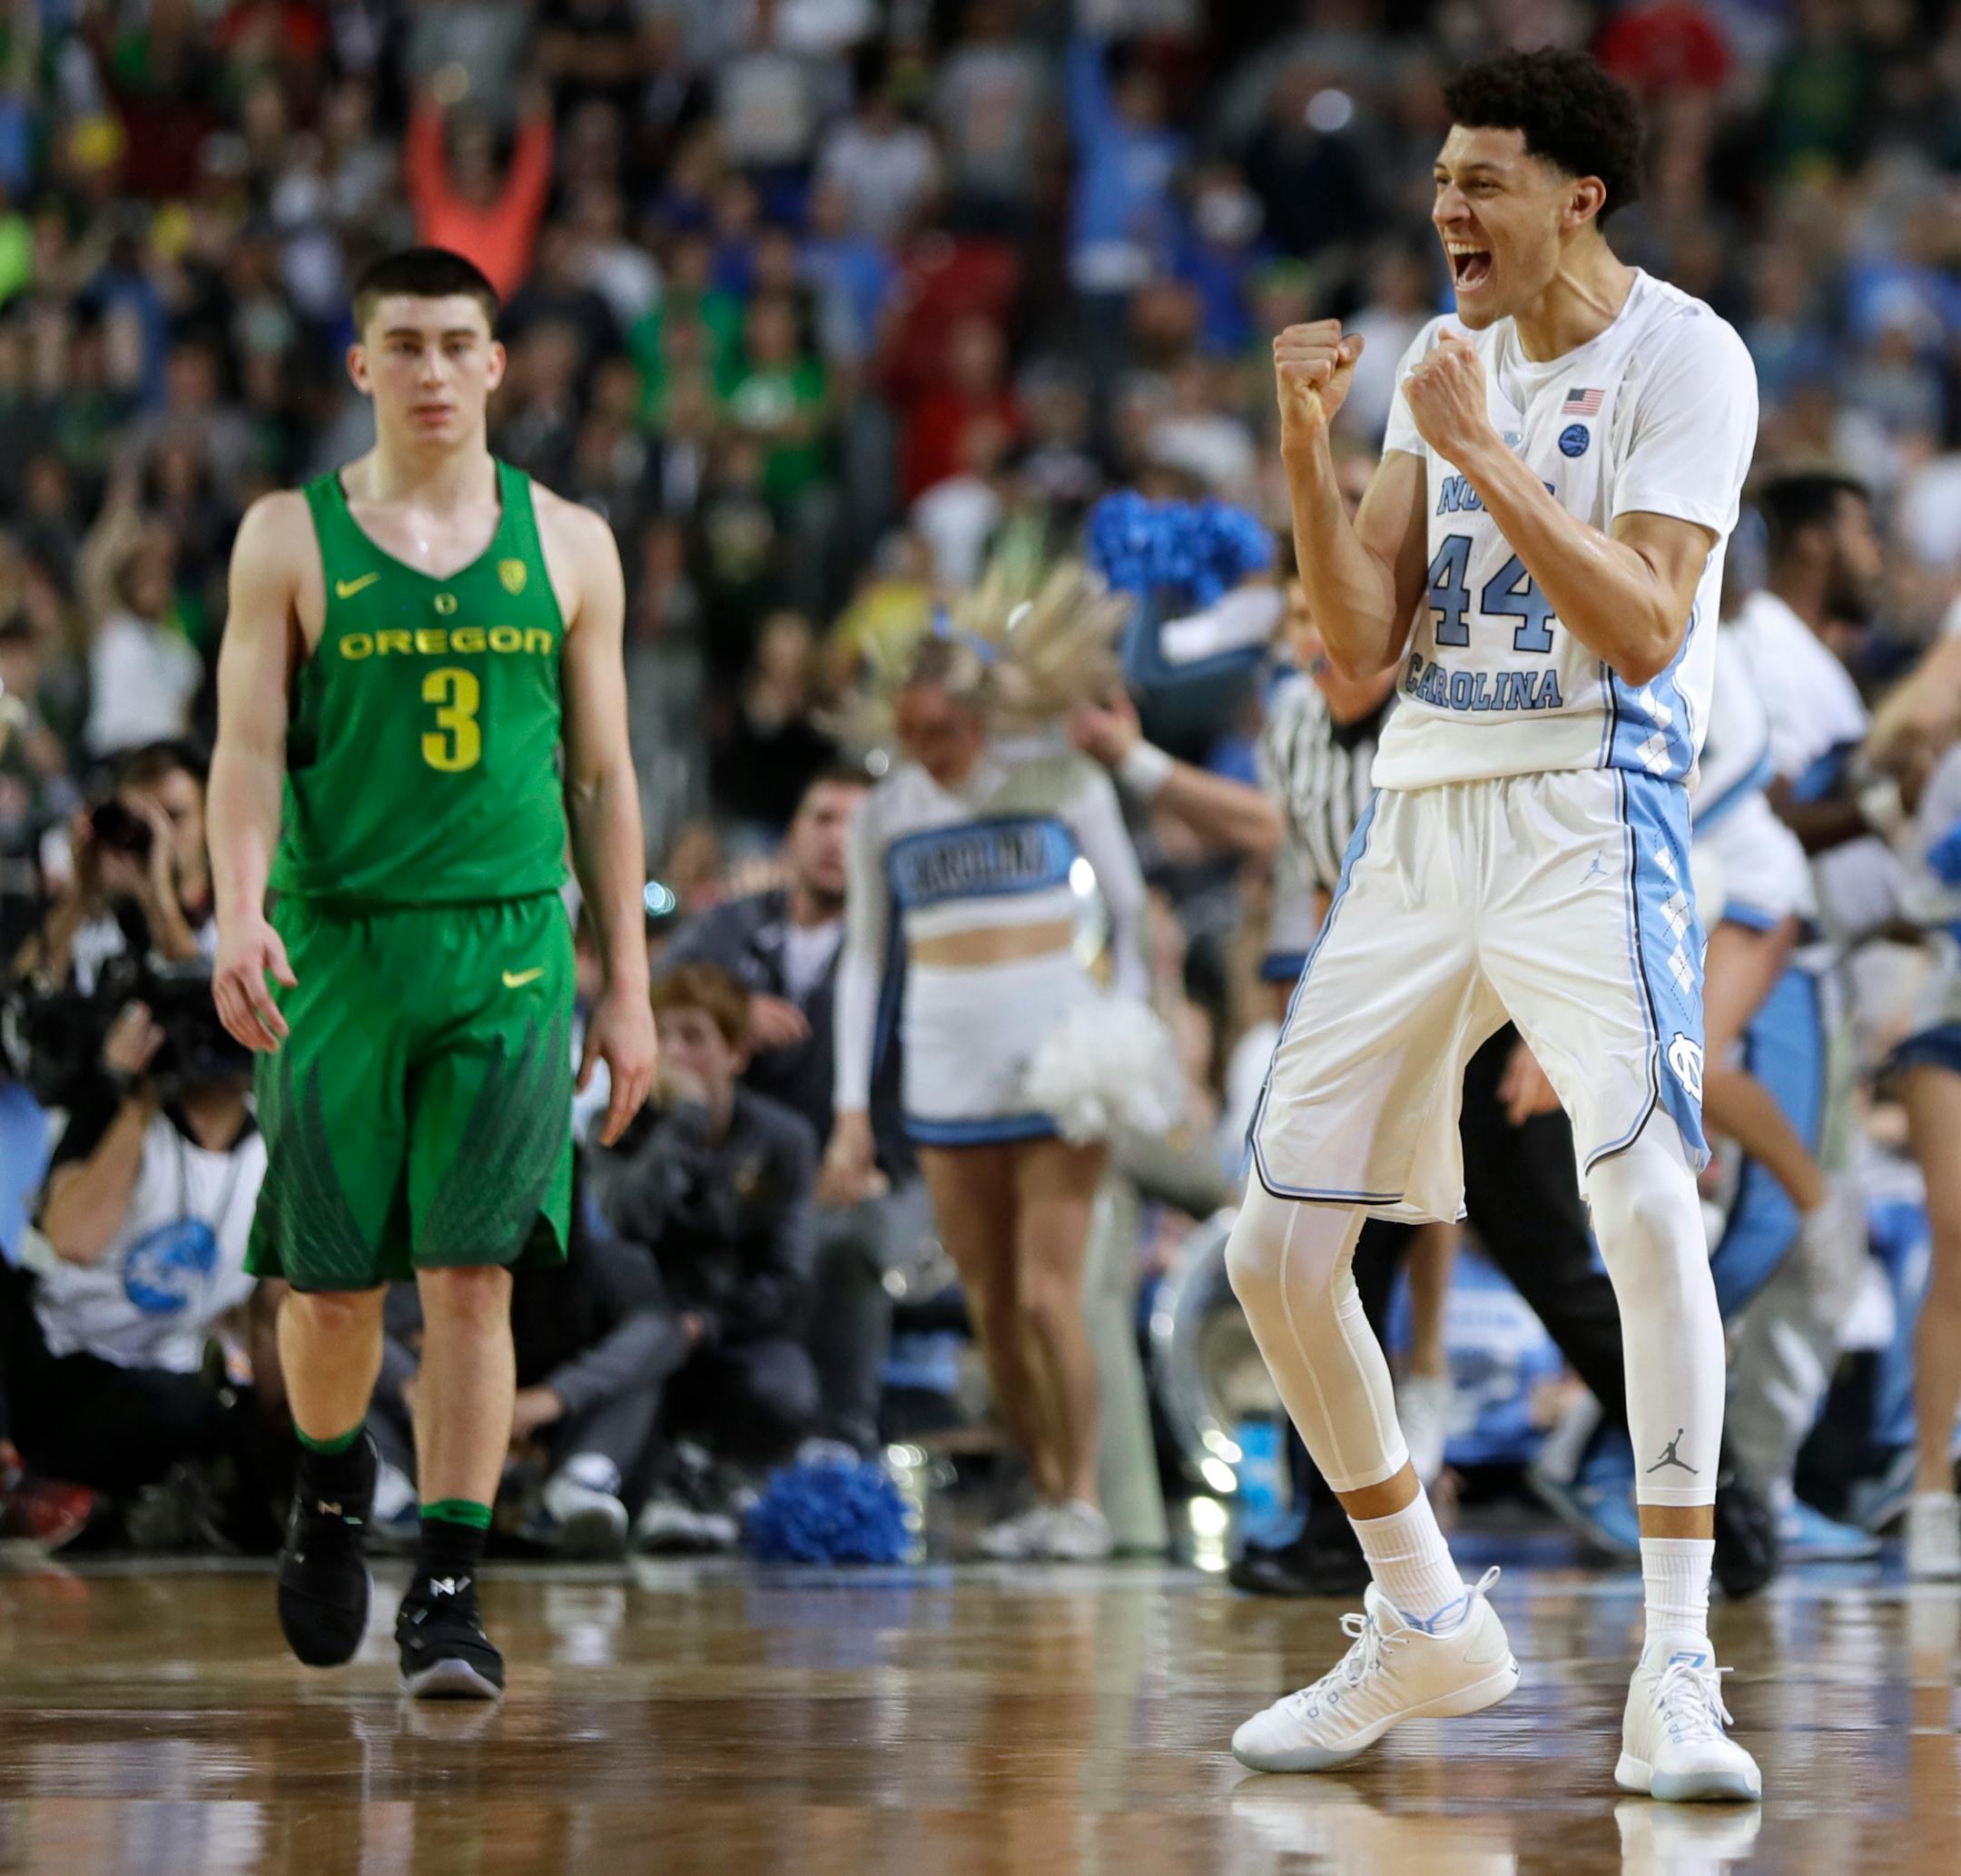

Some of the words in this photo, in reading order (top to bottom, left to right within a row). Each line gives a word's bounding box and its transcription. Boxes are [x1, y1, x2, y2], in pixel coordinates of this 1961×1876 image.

[1428, 534, 1556, 654] 44
[340, 626, 552, 660] OREGON
[1405, 652, 1563, 711] CAROLINA
[421, 666, 481, 773] 3
